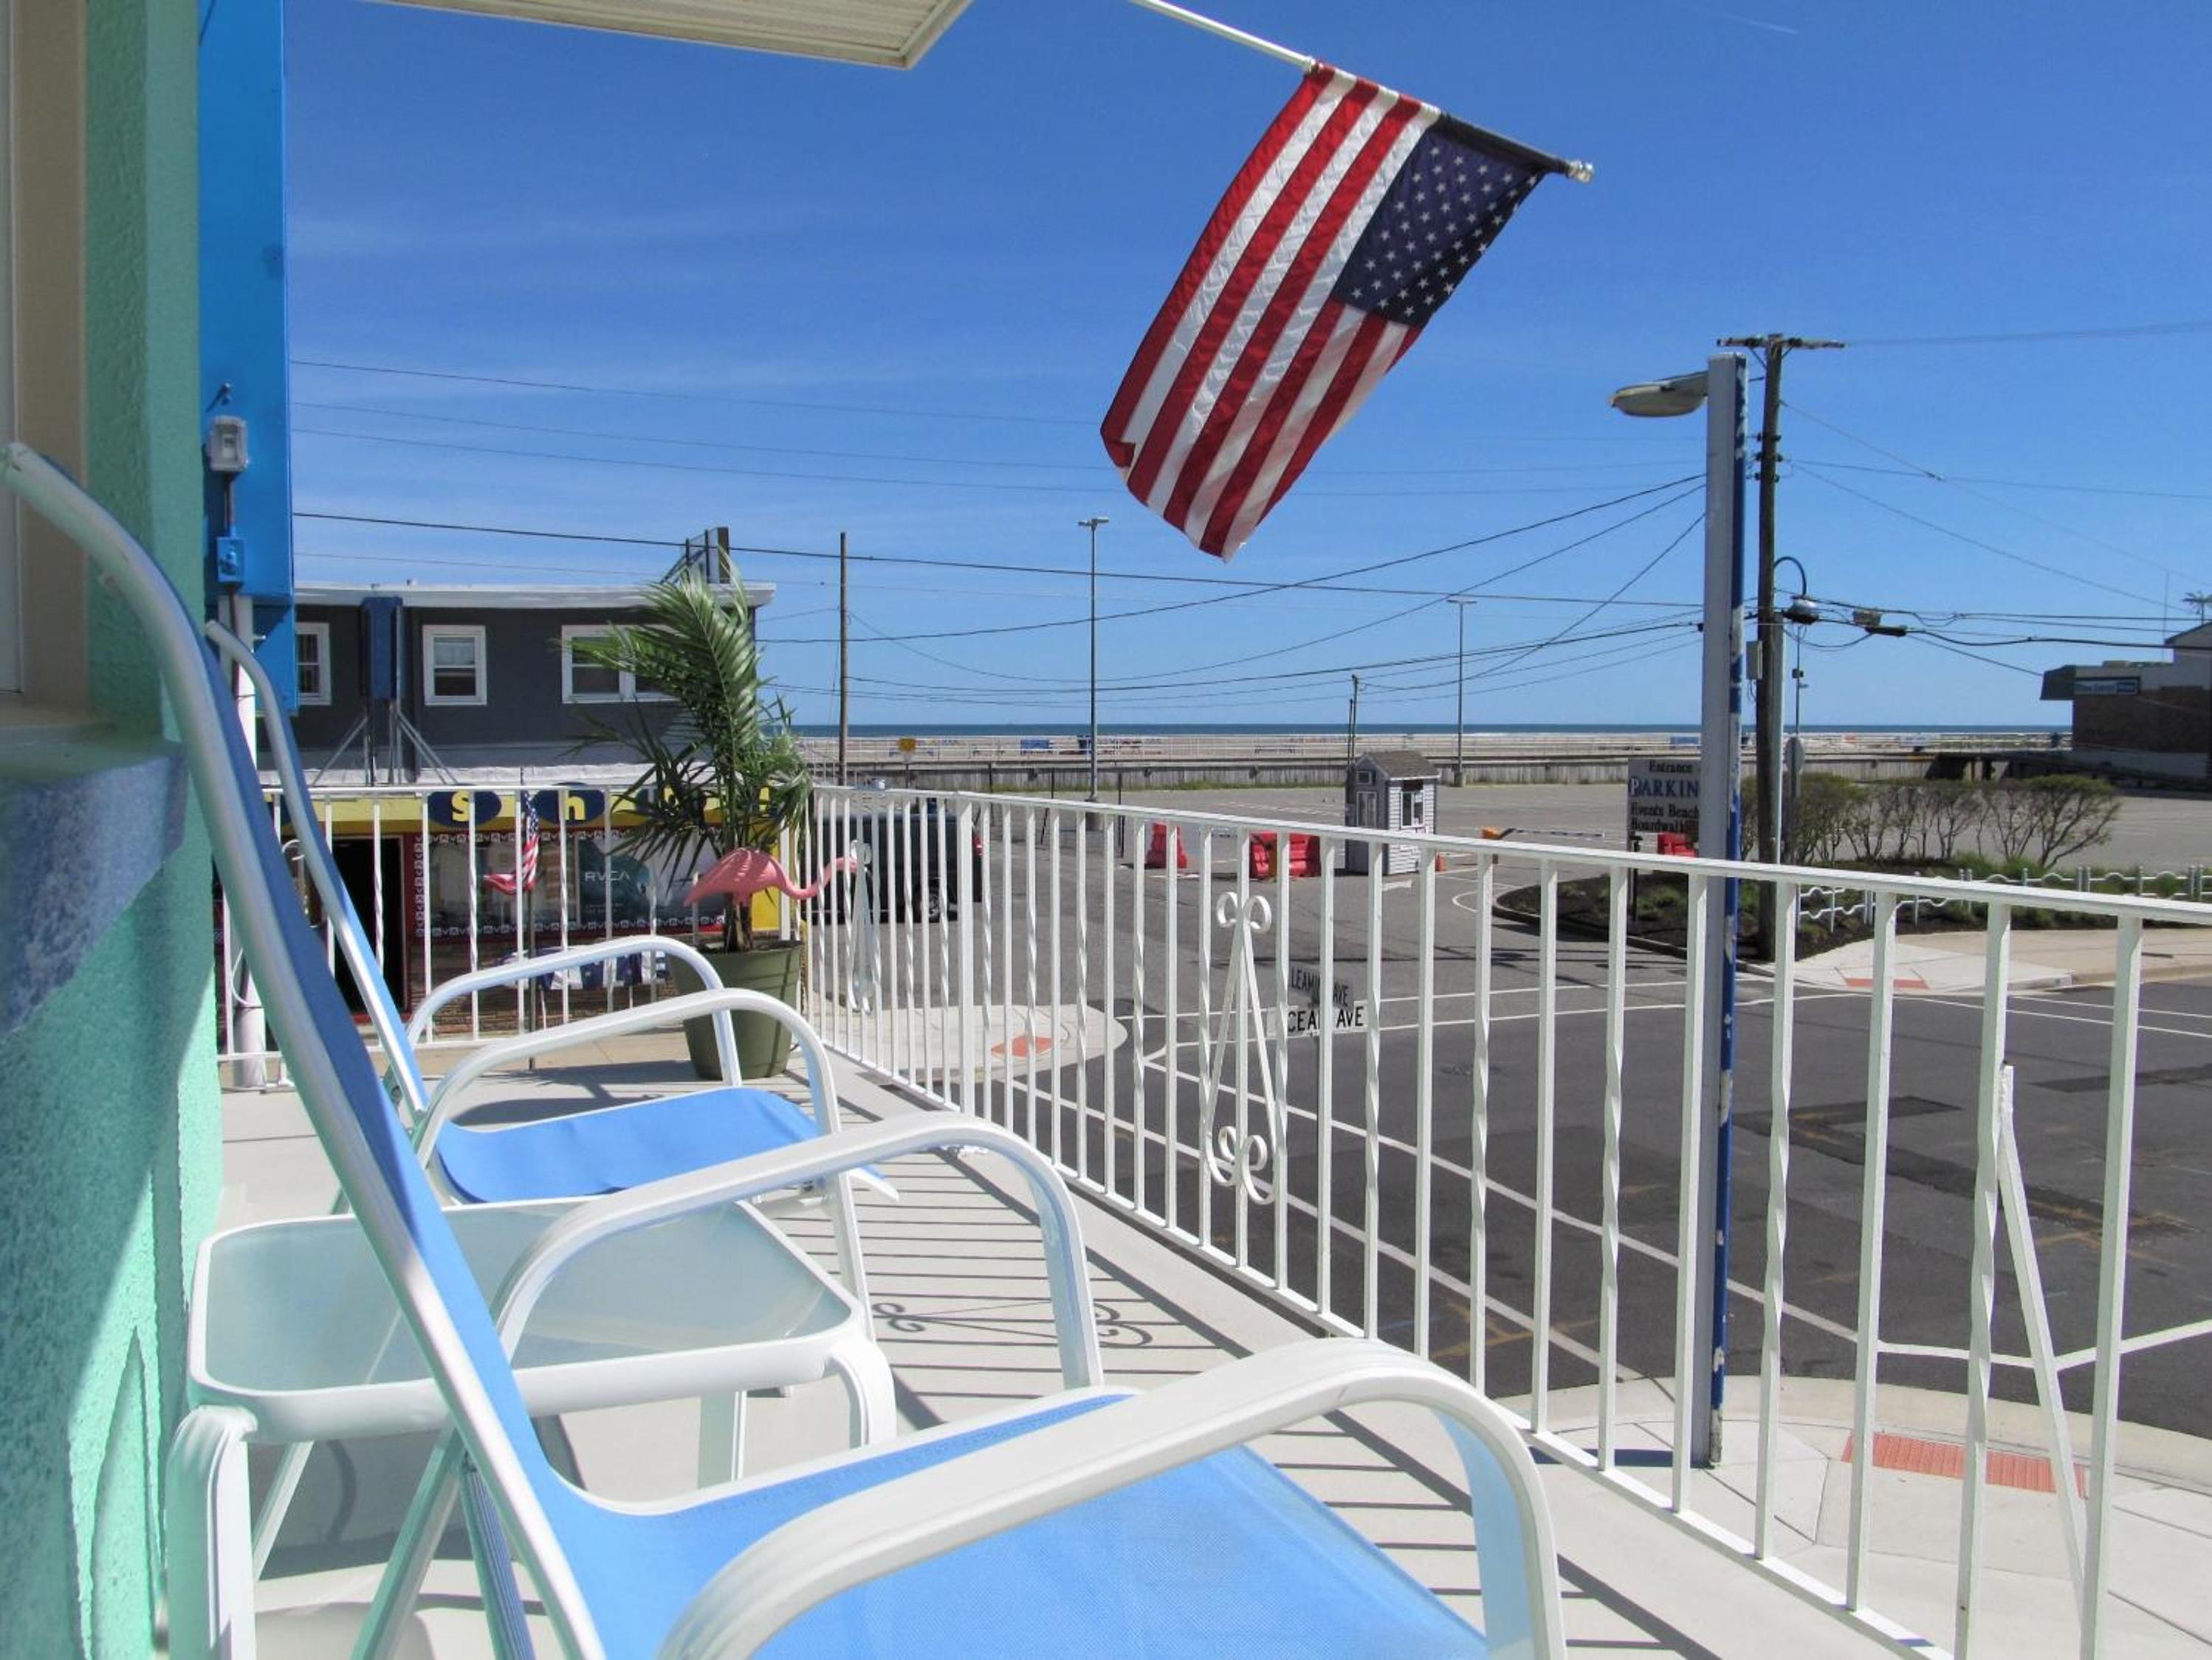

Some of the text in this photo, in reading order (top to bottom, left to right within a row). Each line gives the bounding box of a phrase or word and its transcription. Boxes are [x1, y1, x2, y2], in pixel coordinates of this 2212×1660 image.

[1629, 776, 1700, 797] PARKIN
[1286, 1005, 1364, 1033] CEA AVE
